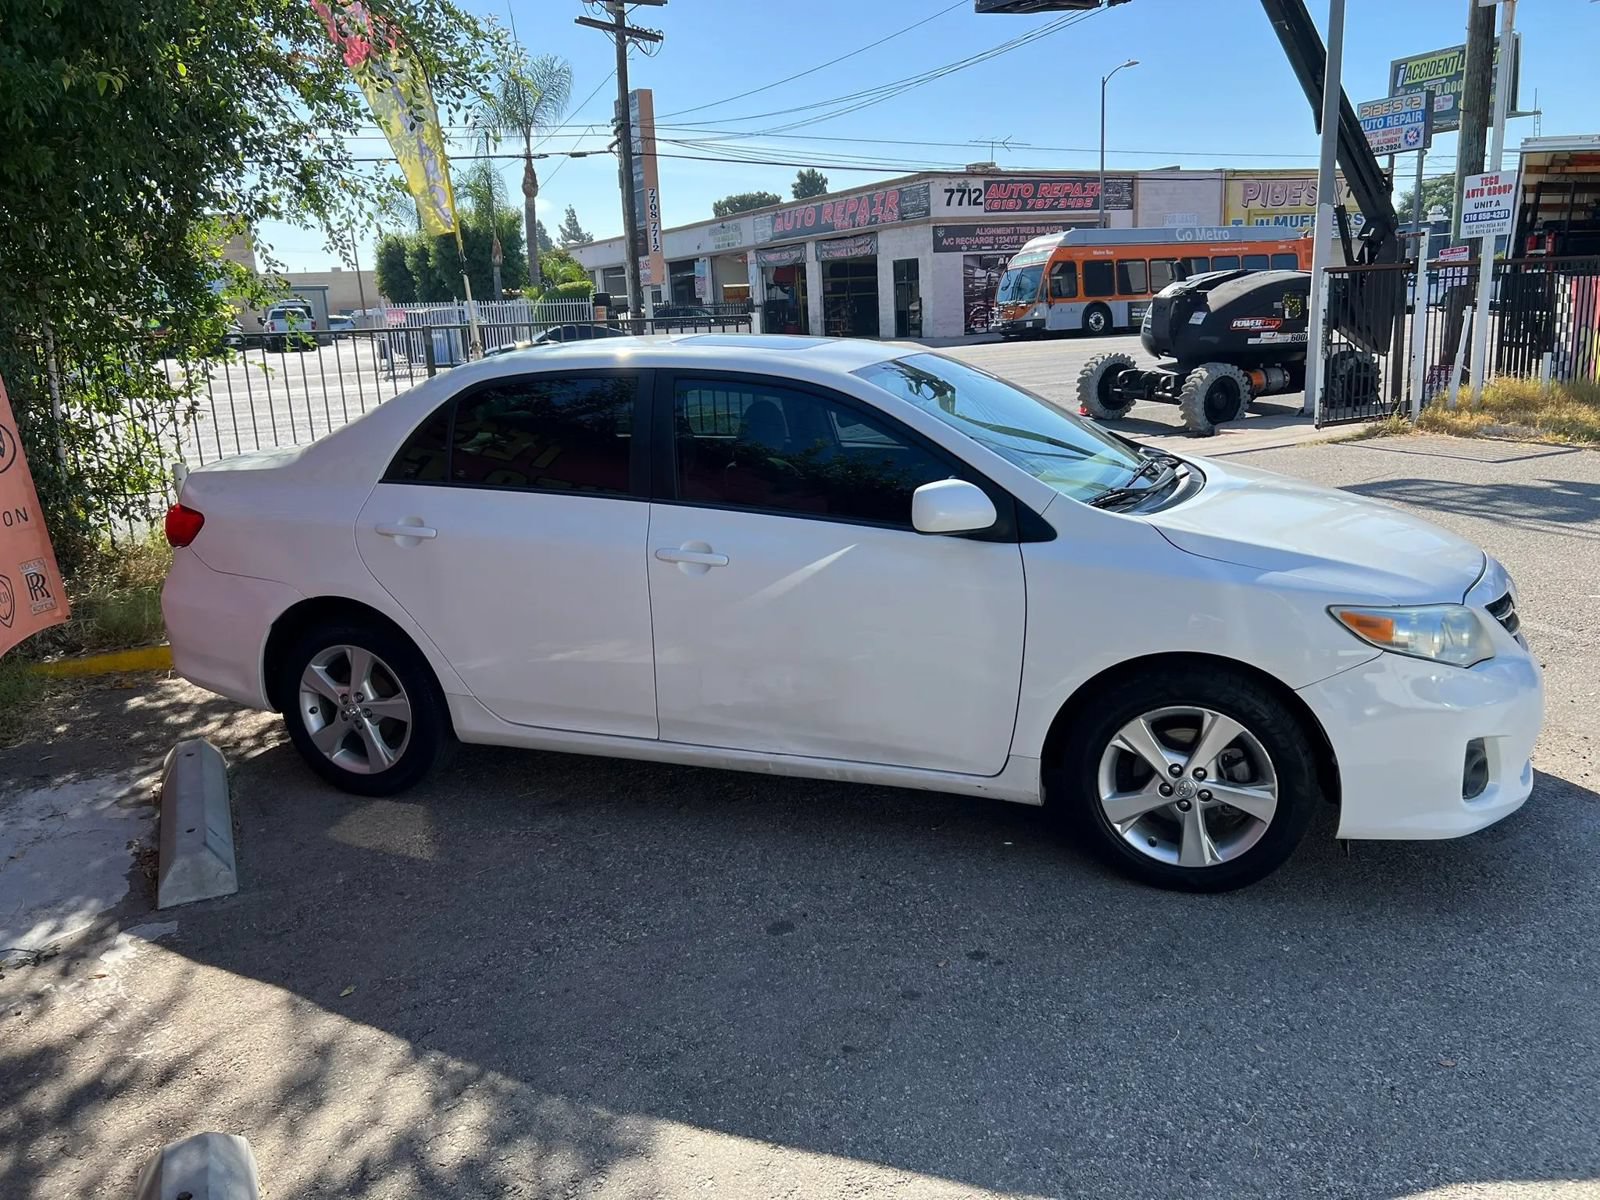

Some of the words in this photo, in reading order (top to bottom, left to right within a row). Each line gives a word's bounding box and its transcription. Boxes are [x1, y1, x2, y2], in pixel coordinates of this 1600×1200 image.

[1360, 118, 1384, 131] AUTO
[1386, 110, 1422, 127] REPAIR
[943, 188, 984, 207] 7712
[984, 182, 1034, 199] AUTO
[1241, 180, 1318, 208] PIBE'S
[1465, 187, 1485, 199] AUTO
[1487, 184, 1513, 197] GROUP
[648, 187, 658, 219] 7708
[773, 207, 816, 233] AUTO
[821, 188, 900, 225] REPAIR
[984, 198, 1022, 211] (818)
[1474, 200, 1493, 210] UNIT
[1494, 199, 1501, 207] A
[1273, 212, 1364, 228] MUFFES
[650, 221, 660, 252] 7712
[975, 226, 1016, 236] ALIGNMENT
[1016, 225, 1035, 234] TIRES
[1175, 228, 1193, 241] Go
[1195, 228, 1230, 241] Metro
[942, 237, 955, 246] A/C
[955, 235, 994, 246] RECHARGE
